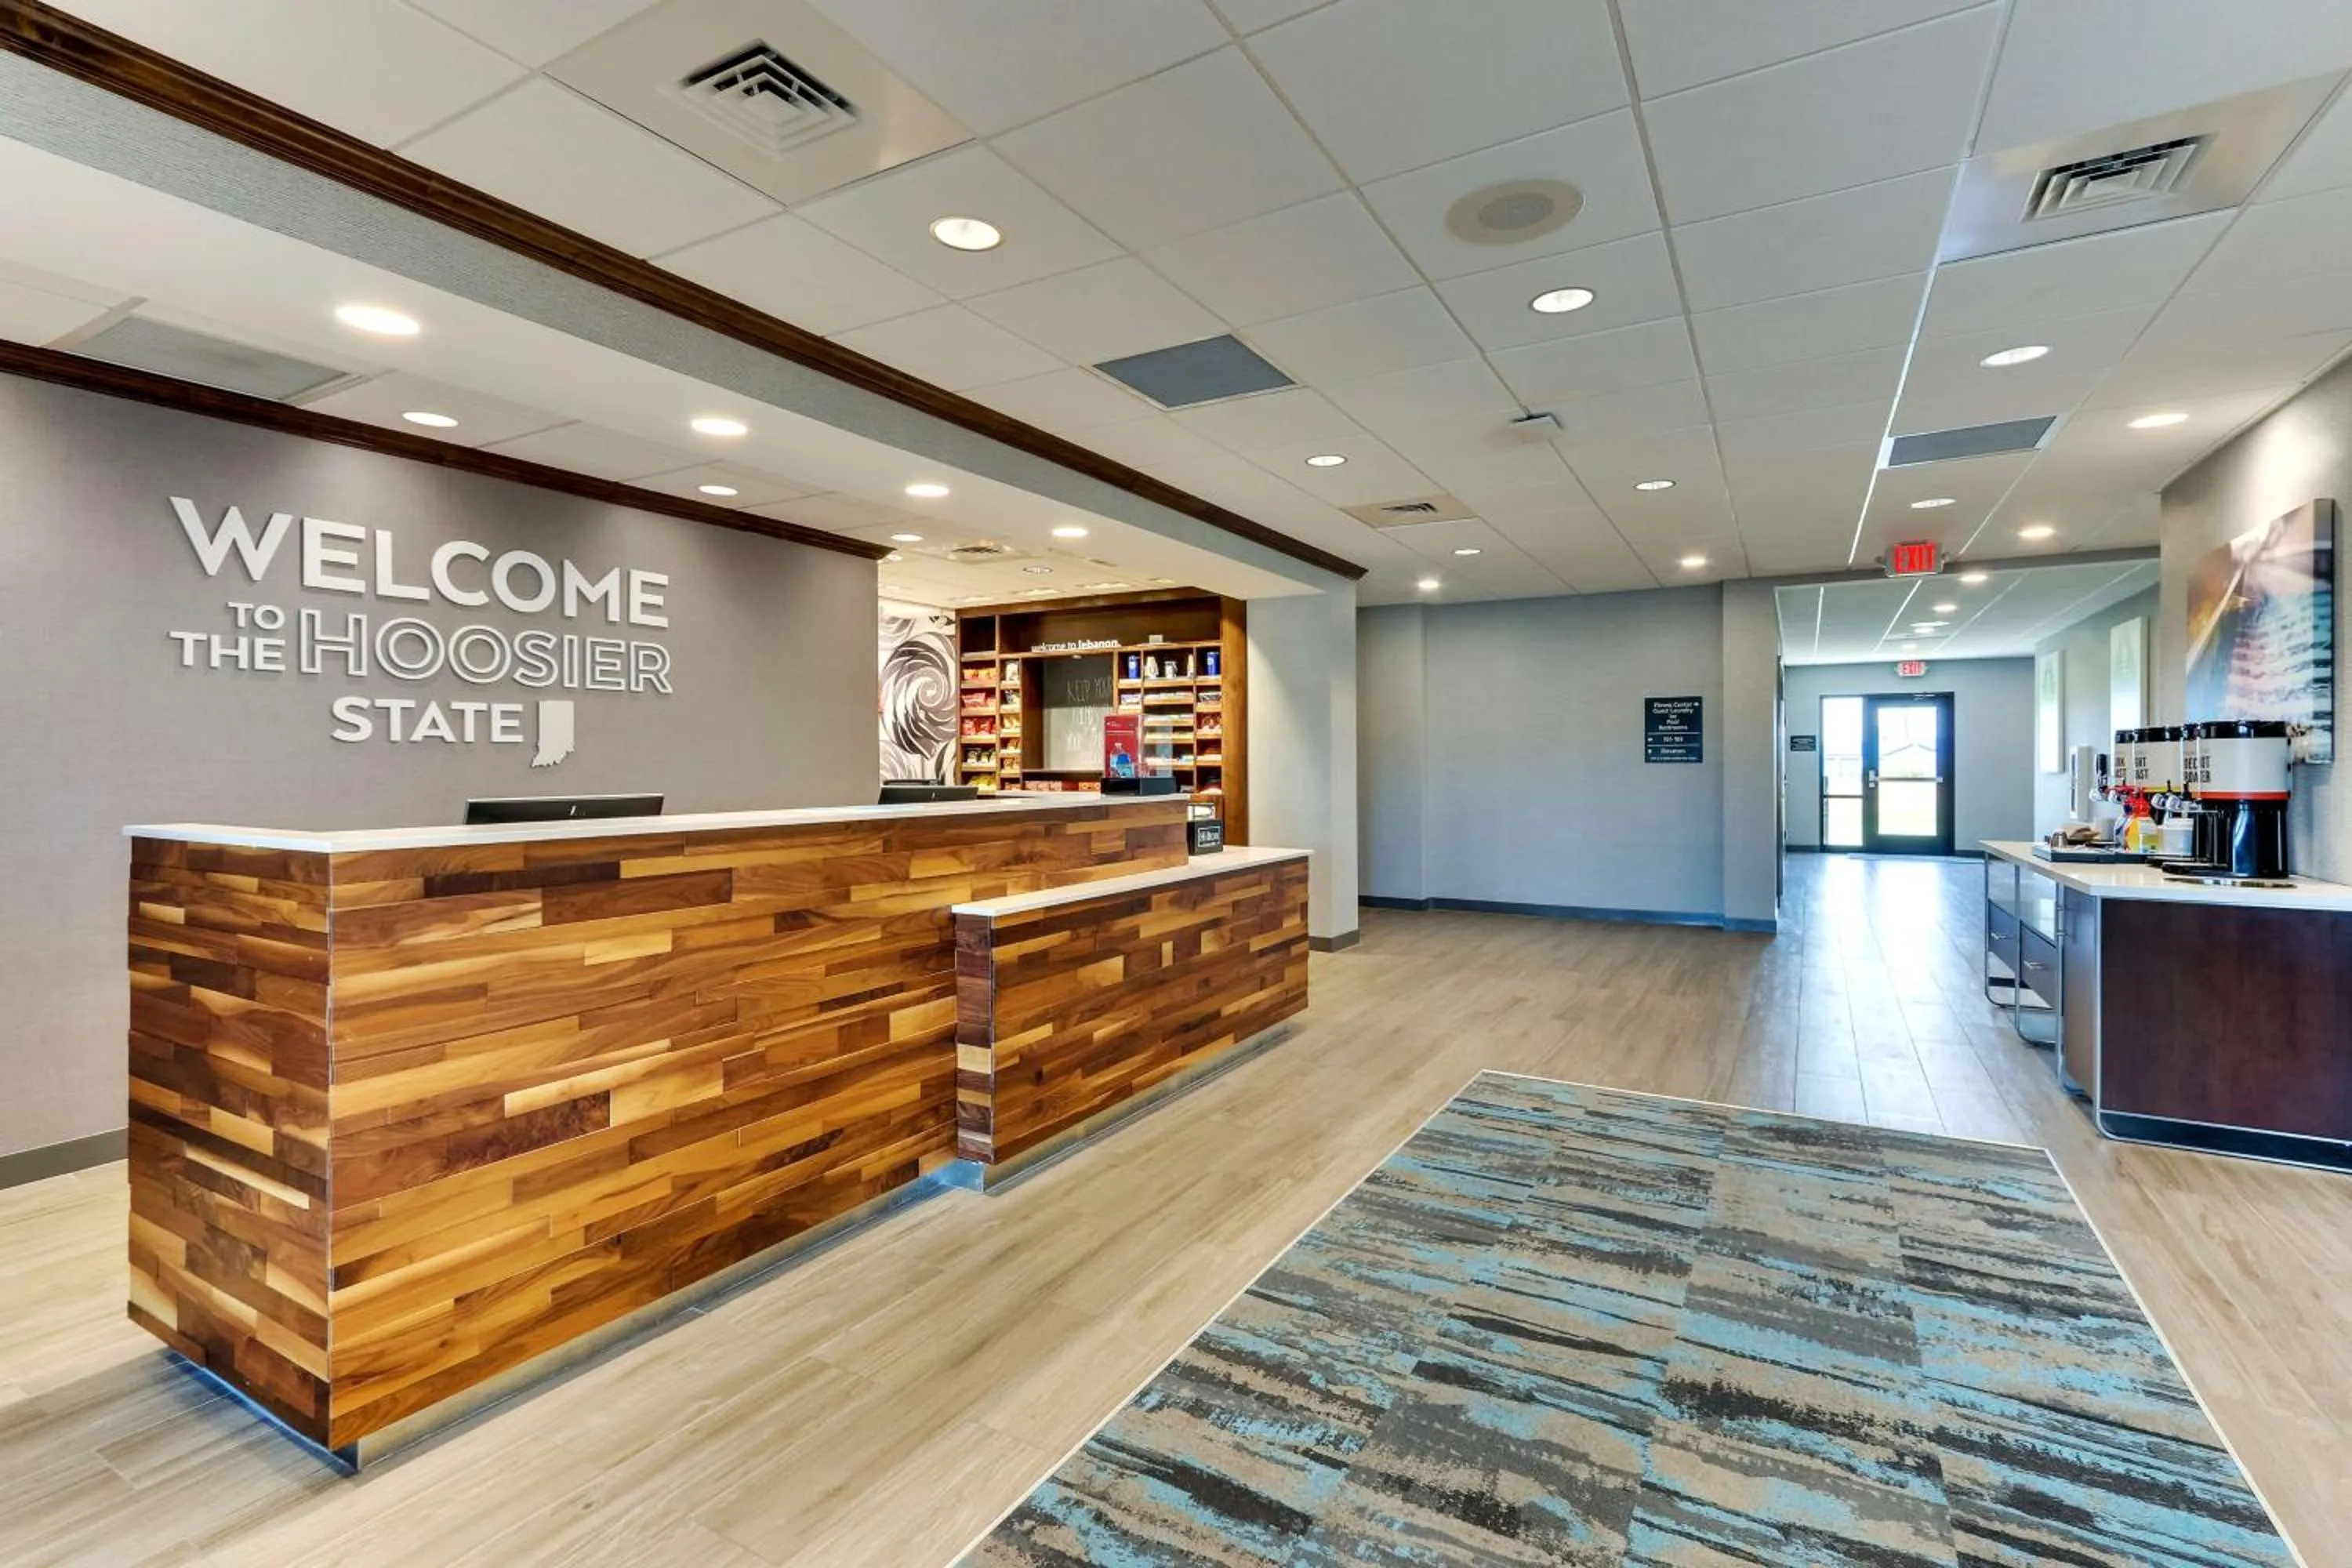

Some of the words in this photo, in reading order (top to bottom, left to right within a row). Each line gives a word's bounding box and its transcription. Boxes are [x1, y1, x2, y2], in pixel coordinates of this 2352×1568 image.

[169, 496, 669, 628] WELCOME
[1895, 544, 1934, 572] EXIT
[227, 601, 285, 630] TO
[169, 630, 286, 672] THE
[299, 609, 673, 694] HOOSIER
[1031, 642, 1066, 653] welcome
[1903, 662, 1922, 674] EXIT
[331, 696, 524, 742] STATE
